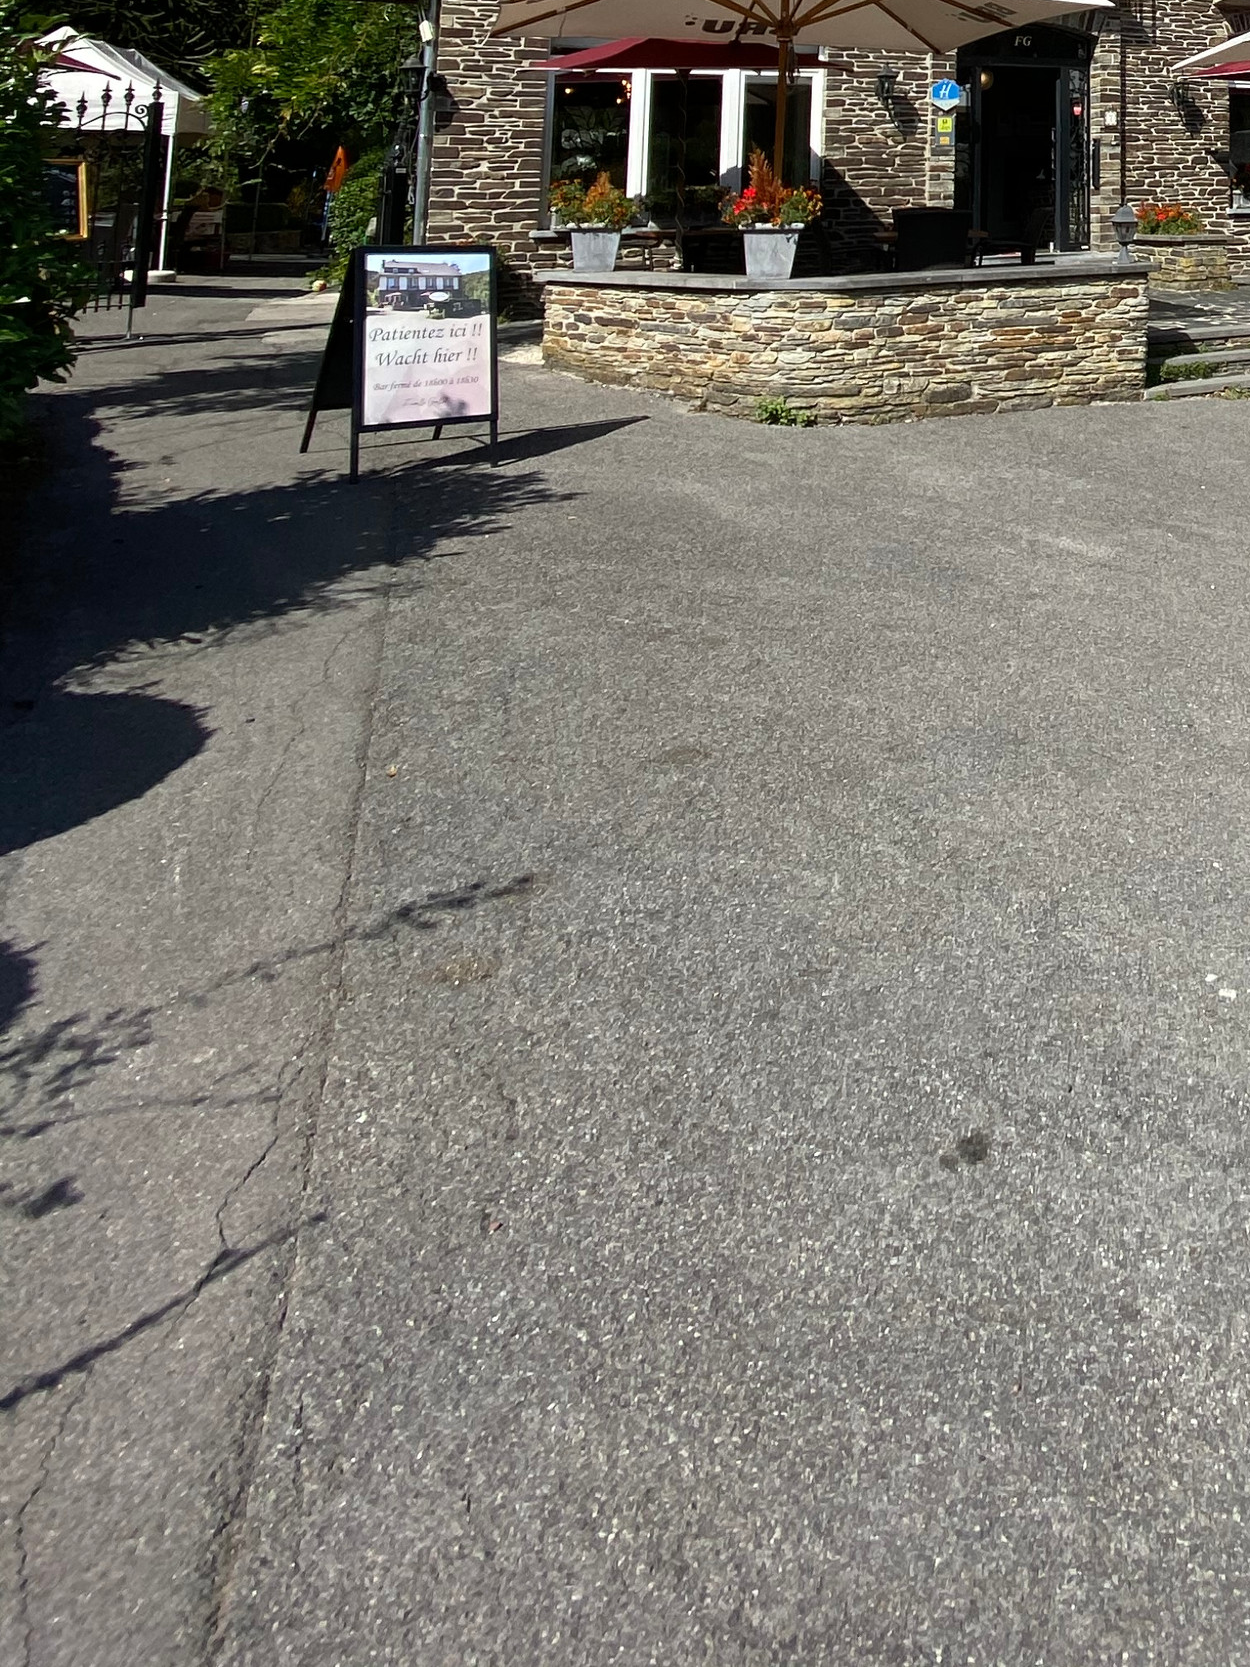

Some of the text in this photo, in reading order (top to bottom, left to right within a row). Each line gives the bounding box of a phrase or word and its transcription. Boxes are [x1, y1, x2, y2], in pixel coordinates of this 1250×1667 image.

[1014, 35, 1033, 47] FG
[369, 325, 445, 342] Patientez
[449, 323, 468, 338] ici
[375, 347, 428, 366] Wacht
[433, 347, 463, 364] hier
